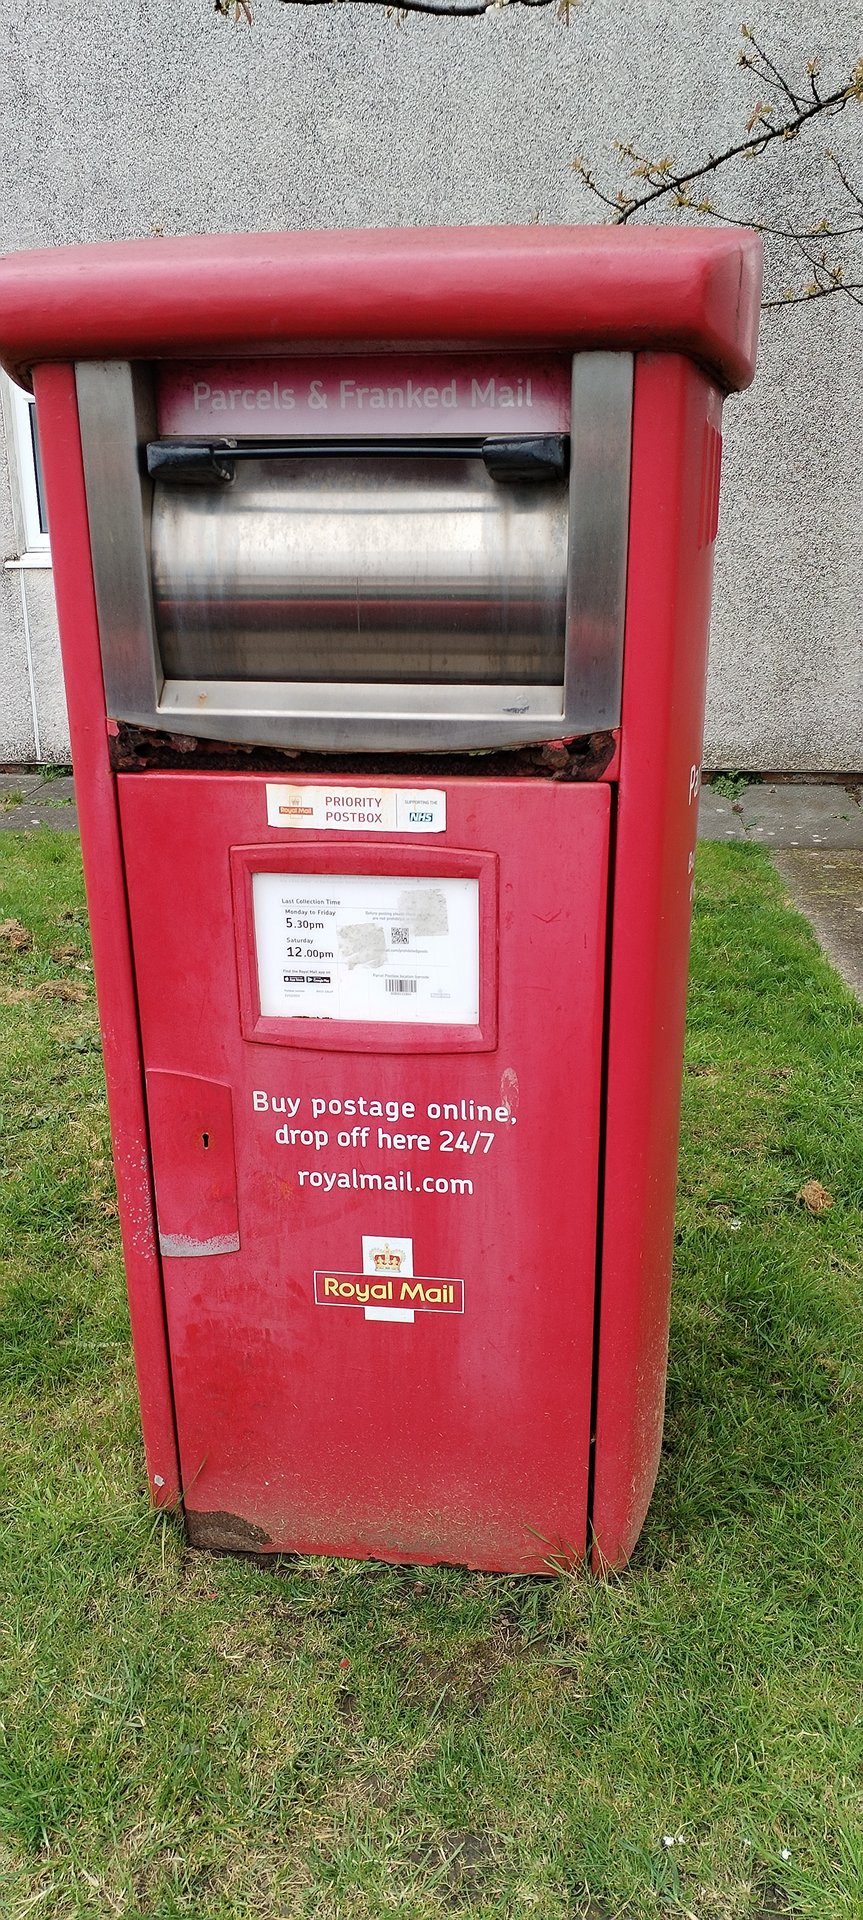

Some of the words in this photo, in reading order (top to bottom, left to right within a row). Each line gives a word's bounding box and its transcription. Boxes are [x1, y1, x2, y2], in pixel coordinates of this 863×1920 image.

[193, 381, 296, 410] Parcels
[308, 380, 328, 410] &
[339, 379, 458, 409] Franked
[471, 378, 533, 408] Mail
[325, 796, 382, 808] PRIORITY
[281, 807, 298, 815] Royal
[298, 807, 313, 815] Mail
[326, 811, 382, 823] POSTBOX
[411, 812, 433, 822] NHS
[286, 917, 324, 930] 5.30pm
[286, 946, 334, 959] 12.00pm
[252, 1090, 301, 1118] Buy
[311, 1096, 415, 1122] postage
[427, 1100, 518, 1125] online,
[275, 1124, 329, 1150] drop
[337, 1126, 371, 1148] off
[377, 1128, 431, 1151] here
[439, 1130, 495, 1155] 24/7
[298, 1168, 474, 1195] royalmail.com
[324, 1277, 393, 1303] Royal
[400, 1282, 454, 1304] Mail
